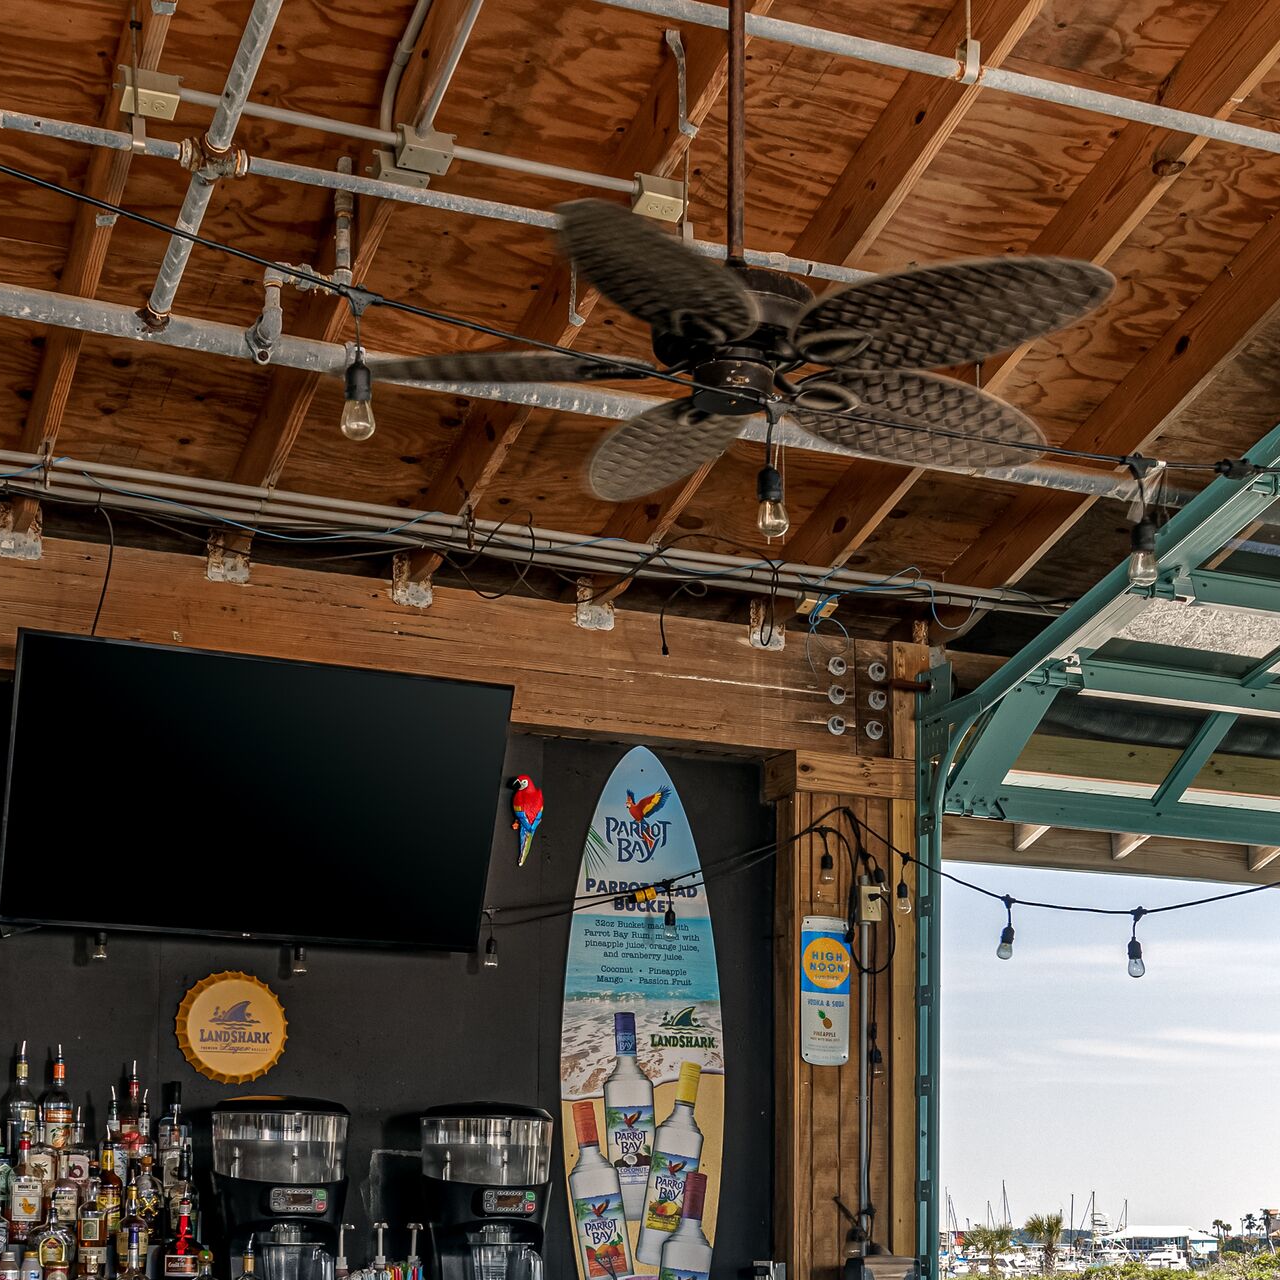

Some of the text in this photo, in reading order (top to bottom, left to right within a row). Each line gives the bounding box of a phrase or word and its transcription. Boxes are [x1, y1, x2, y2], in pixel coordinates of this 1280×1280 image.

[605, 816, 673, 849] PARROT
[616, 837, 661, 863] BAY
[595, 919, 615, 928] 32oz
[617, 920, 645, 930] Bucket
[647, 922, 667, 930] mad
[584, 928, 611, 938] Parrot
[613, 930, 629, 939] Bay
[682, 934, 700, 942] with
[584, 940, 624, 949] pineapple
[649, 942, 677, 951] orange
[603, 950, 619, 958] and
[621, 951, 662, 961] cranberry
[812, 951, 843, 962] HIGH
[600, 965, 687, 977] Coconut Pineapple
[809, 962, 845, 973] NOON
[596, 975, 693, 986] Mango Passion Fruit
[200, 1028, 271, 1044] LANDSHARK
[650, 1033, 716, 1049] LANDSHARK
[220, 1042, 252, 1054] Lager
[614, 1130, 648, 1147] PARROT
[621, 1141, 643, 1154] BAY
[659, 1187, 682, 1201] BAY
[584, 1218, 618, 1237] PARROT
[591, 1228, 613, 1245] BAY
